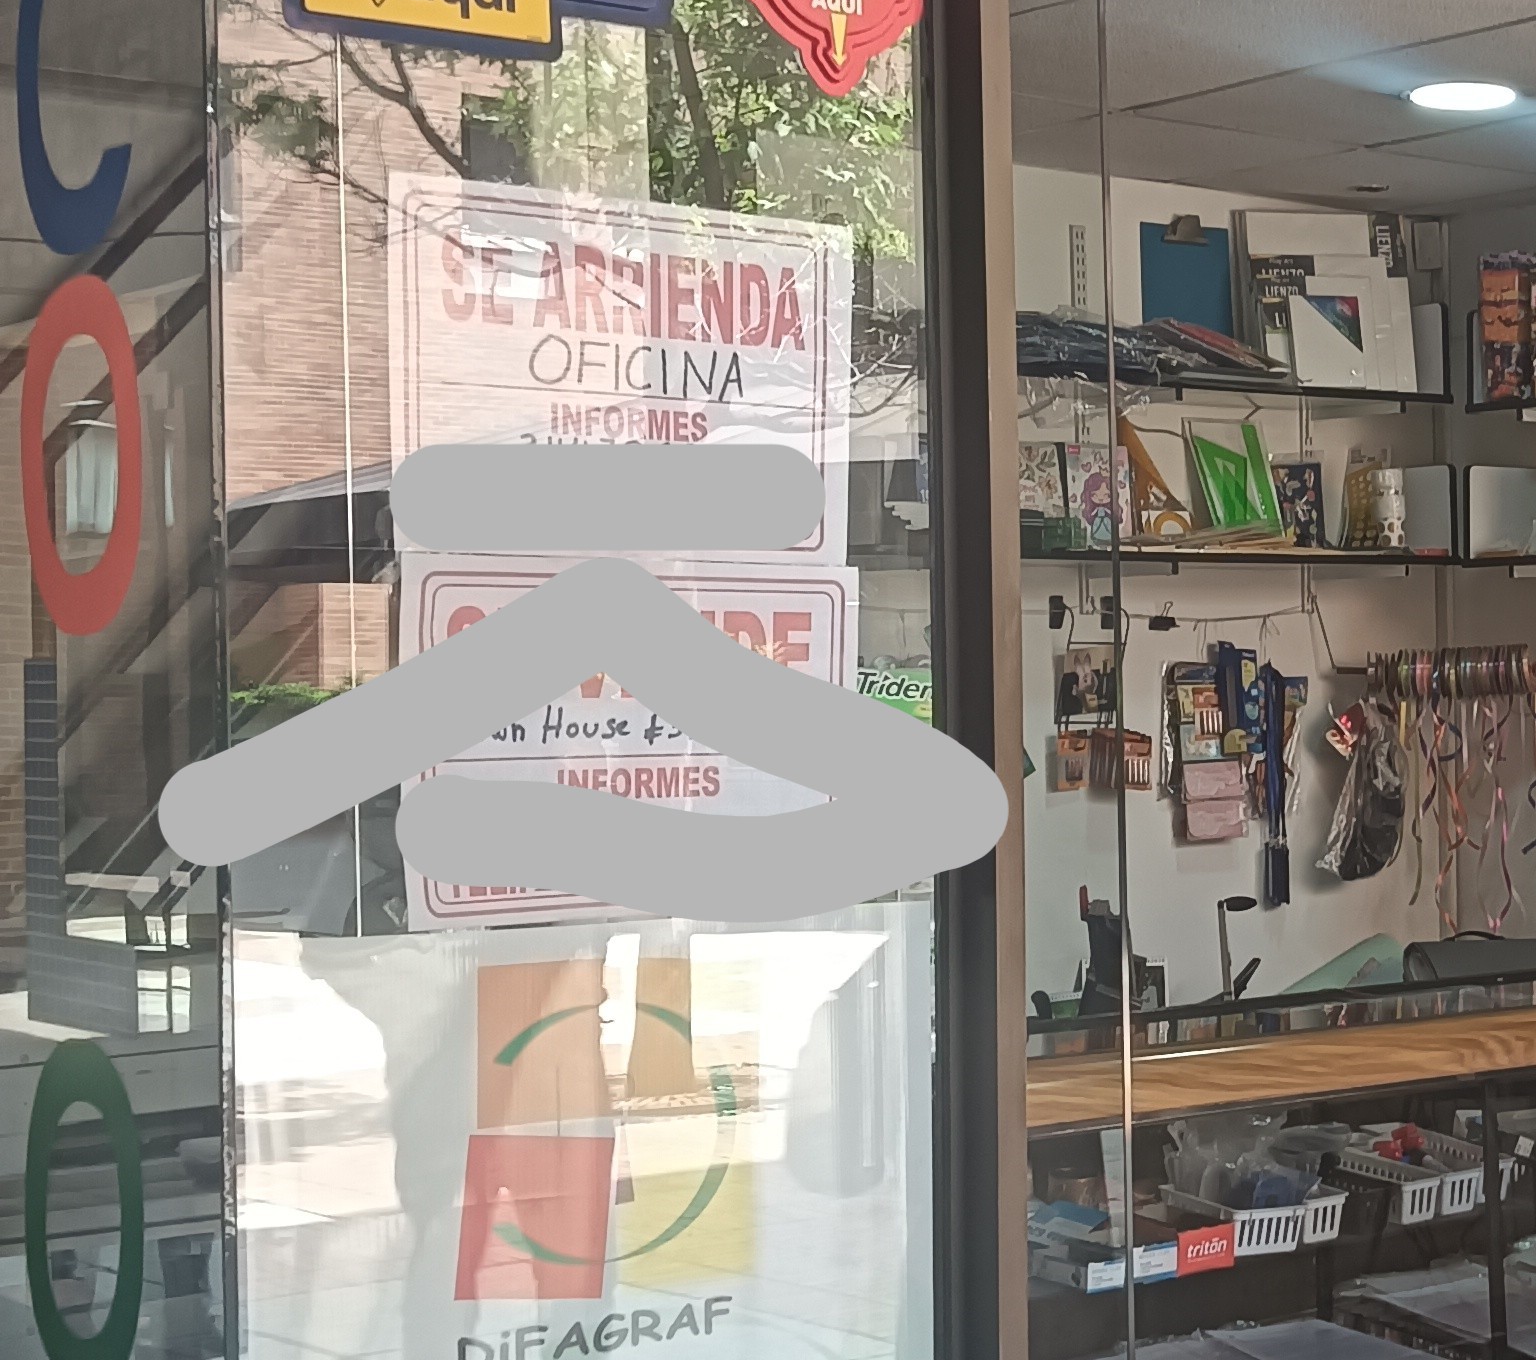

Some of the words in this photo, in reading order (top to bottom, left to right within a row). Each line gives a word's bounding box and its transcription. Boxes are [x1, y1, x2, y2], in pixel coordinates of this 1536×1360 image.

[441, 240, 514, 326] SE
[532, 242, 806, 351] ARRIENDA
[529, 333, 744, 403] OFICINA
[550, 402, 709, 443] INFORMES
[857, 671, 933, 700] Triden
[541, 704, 631, 744] House
